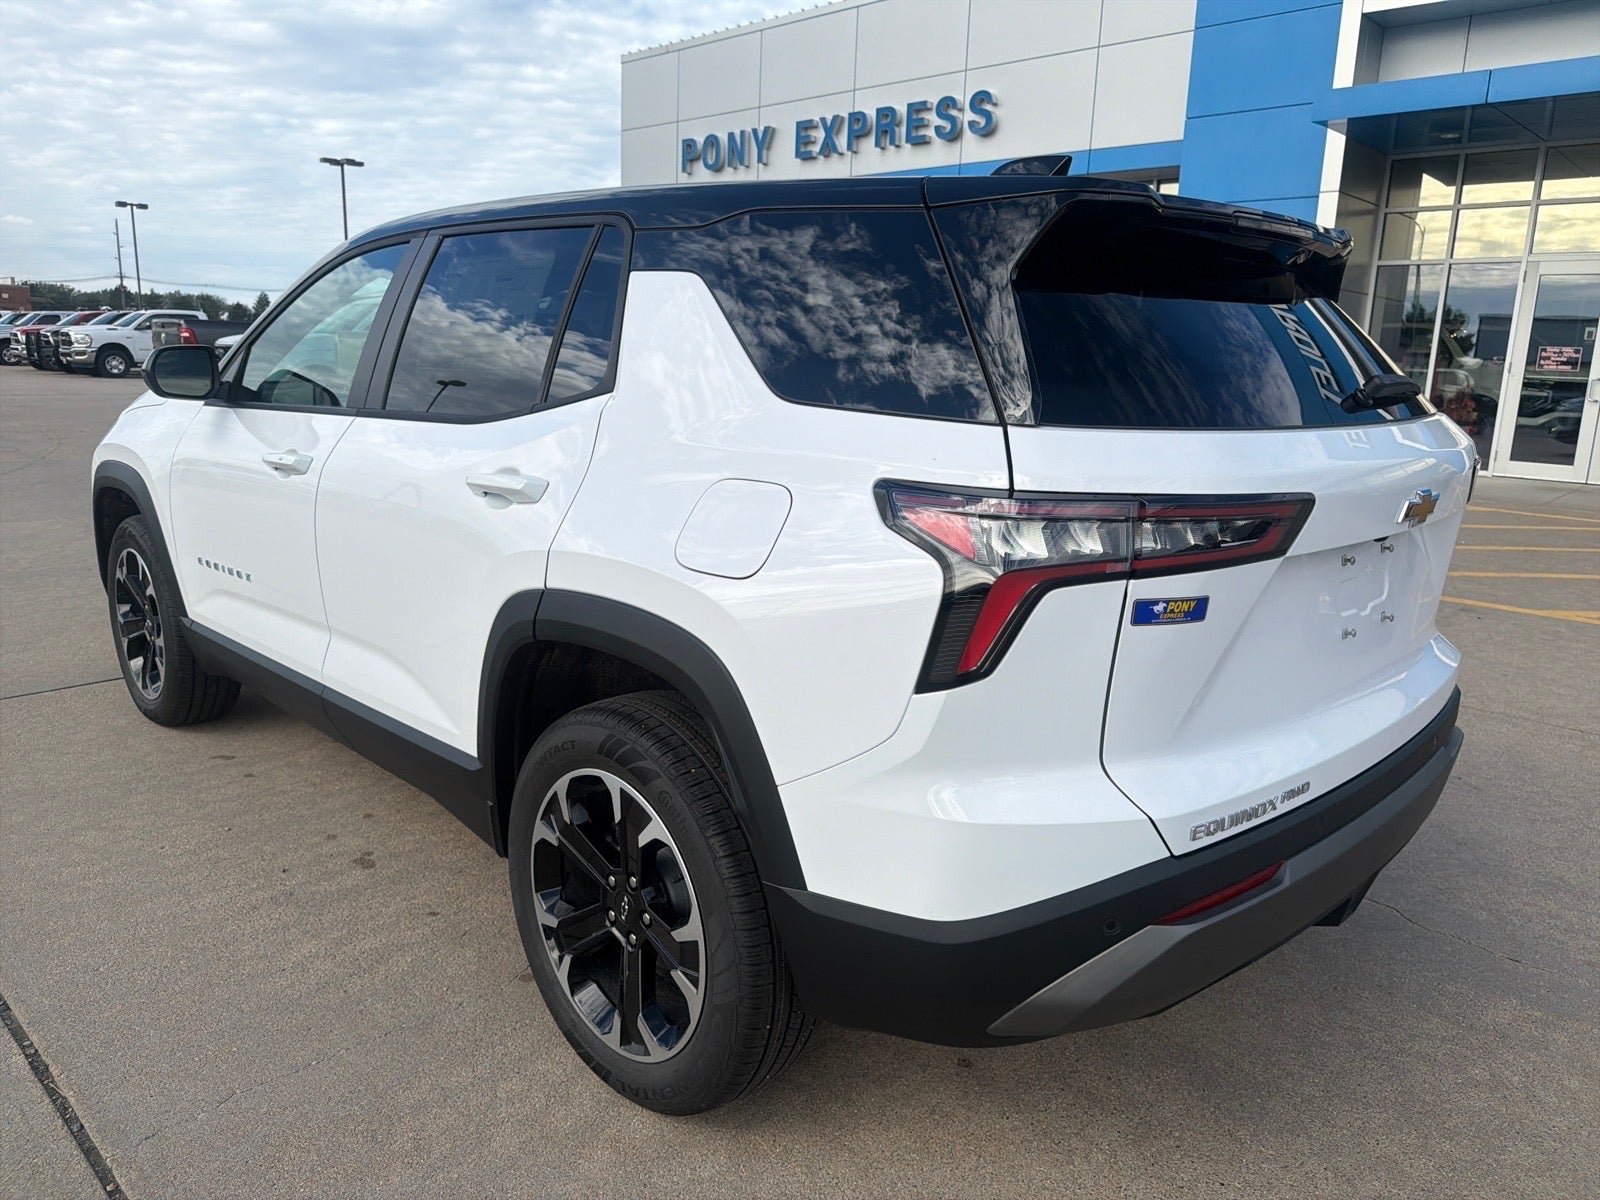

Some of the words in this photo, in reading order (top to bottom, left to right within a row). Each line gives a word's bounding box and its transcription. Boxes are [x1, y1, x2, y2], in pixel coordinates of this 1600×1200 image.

[681, 125, 776, 174] PONY
[794, 89, 998, 161] EXPRESS
[1166, 600, 1197, 613] PONY
[1190, 795, 1279, 842] EQUINOX
